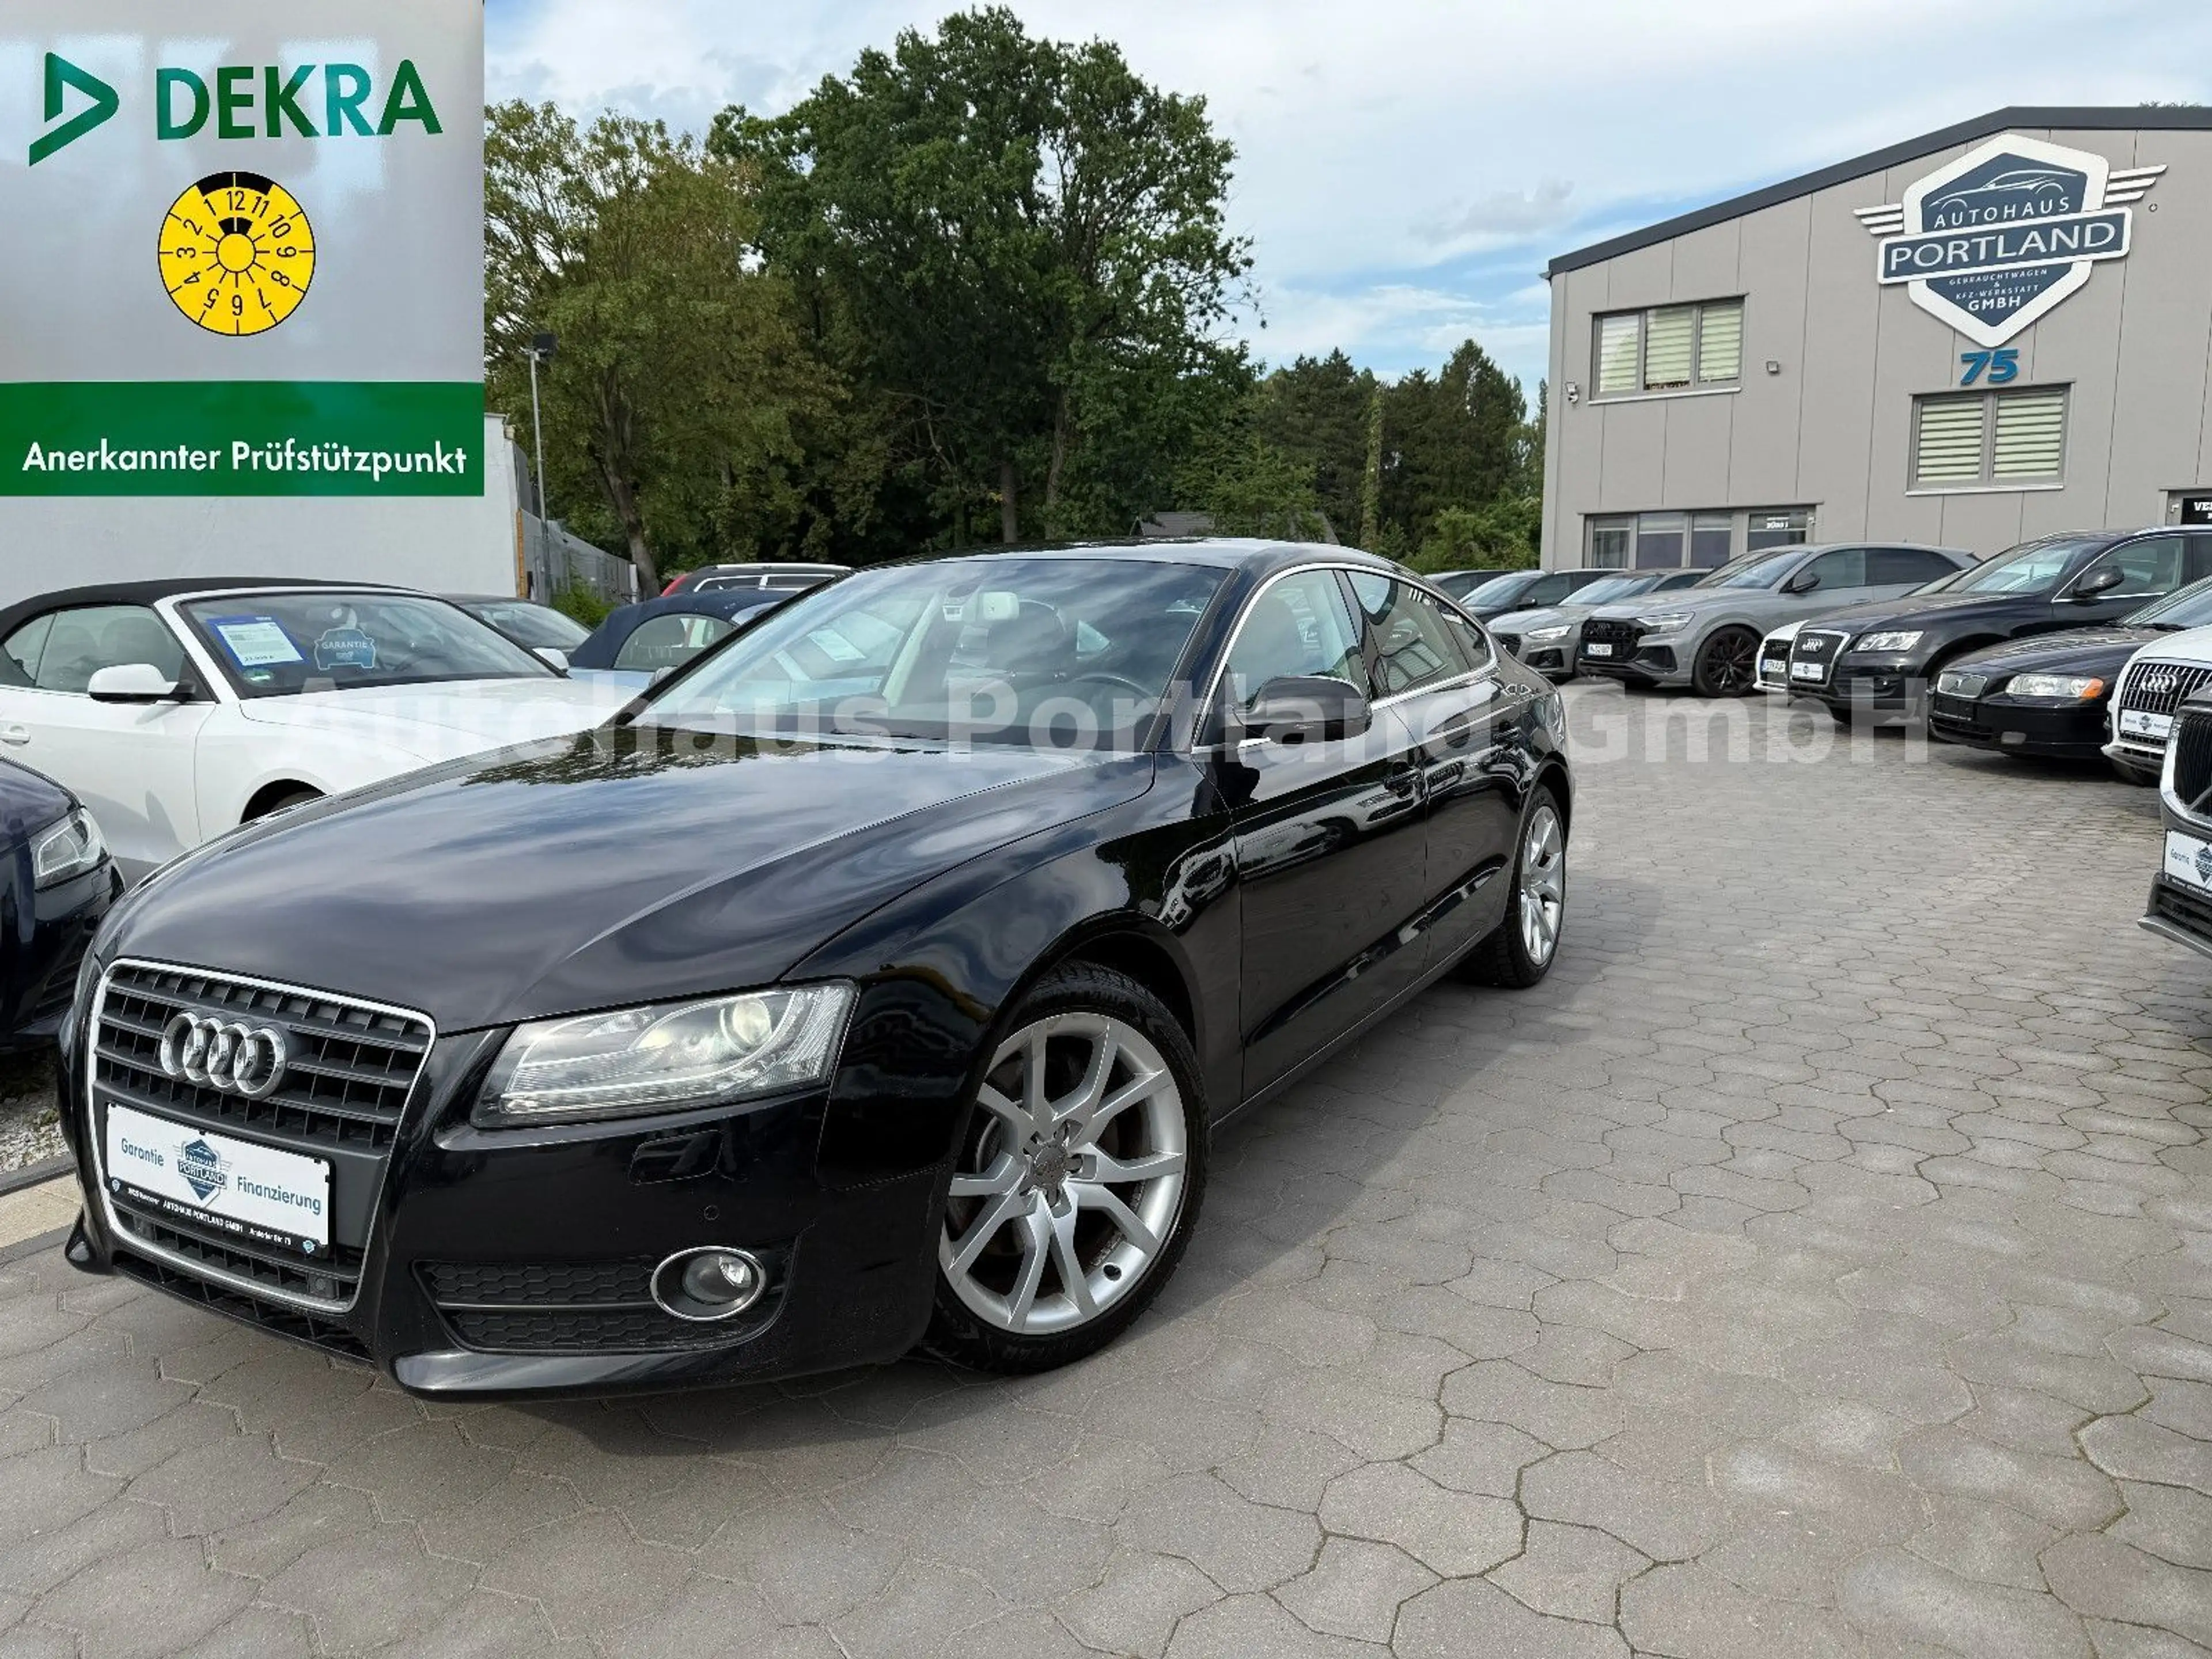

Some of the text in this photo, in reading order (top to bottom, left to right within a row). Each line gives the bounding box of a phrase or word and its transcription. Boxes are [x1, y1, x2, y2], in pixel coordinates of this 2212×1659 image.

[1934, 196, 2070, 228] AUTOHAUS
[1890, 222, 2116, 271] PORTLAND
[1949, 268, 2047, 286] GEBRAUCHTWAGEN
[1956, 285, 2039, 300] KFZ-WERKSTATT
[1968, 296, 2021, 312] GMBH
[1960, 349, 2018, 385] 75
[322, 641, 368, 649] GARANTIE
[121, 1137, 164, 1166] Garantie
[179, 1162, 224, 1184] PORTLAND
[237, 1176, 321, 1216] Finanzierung
